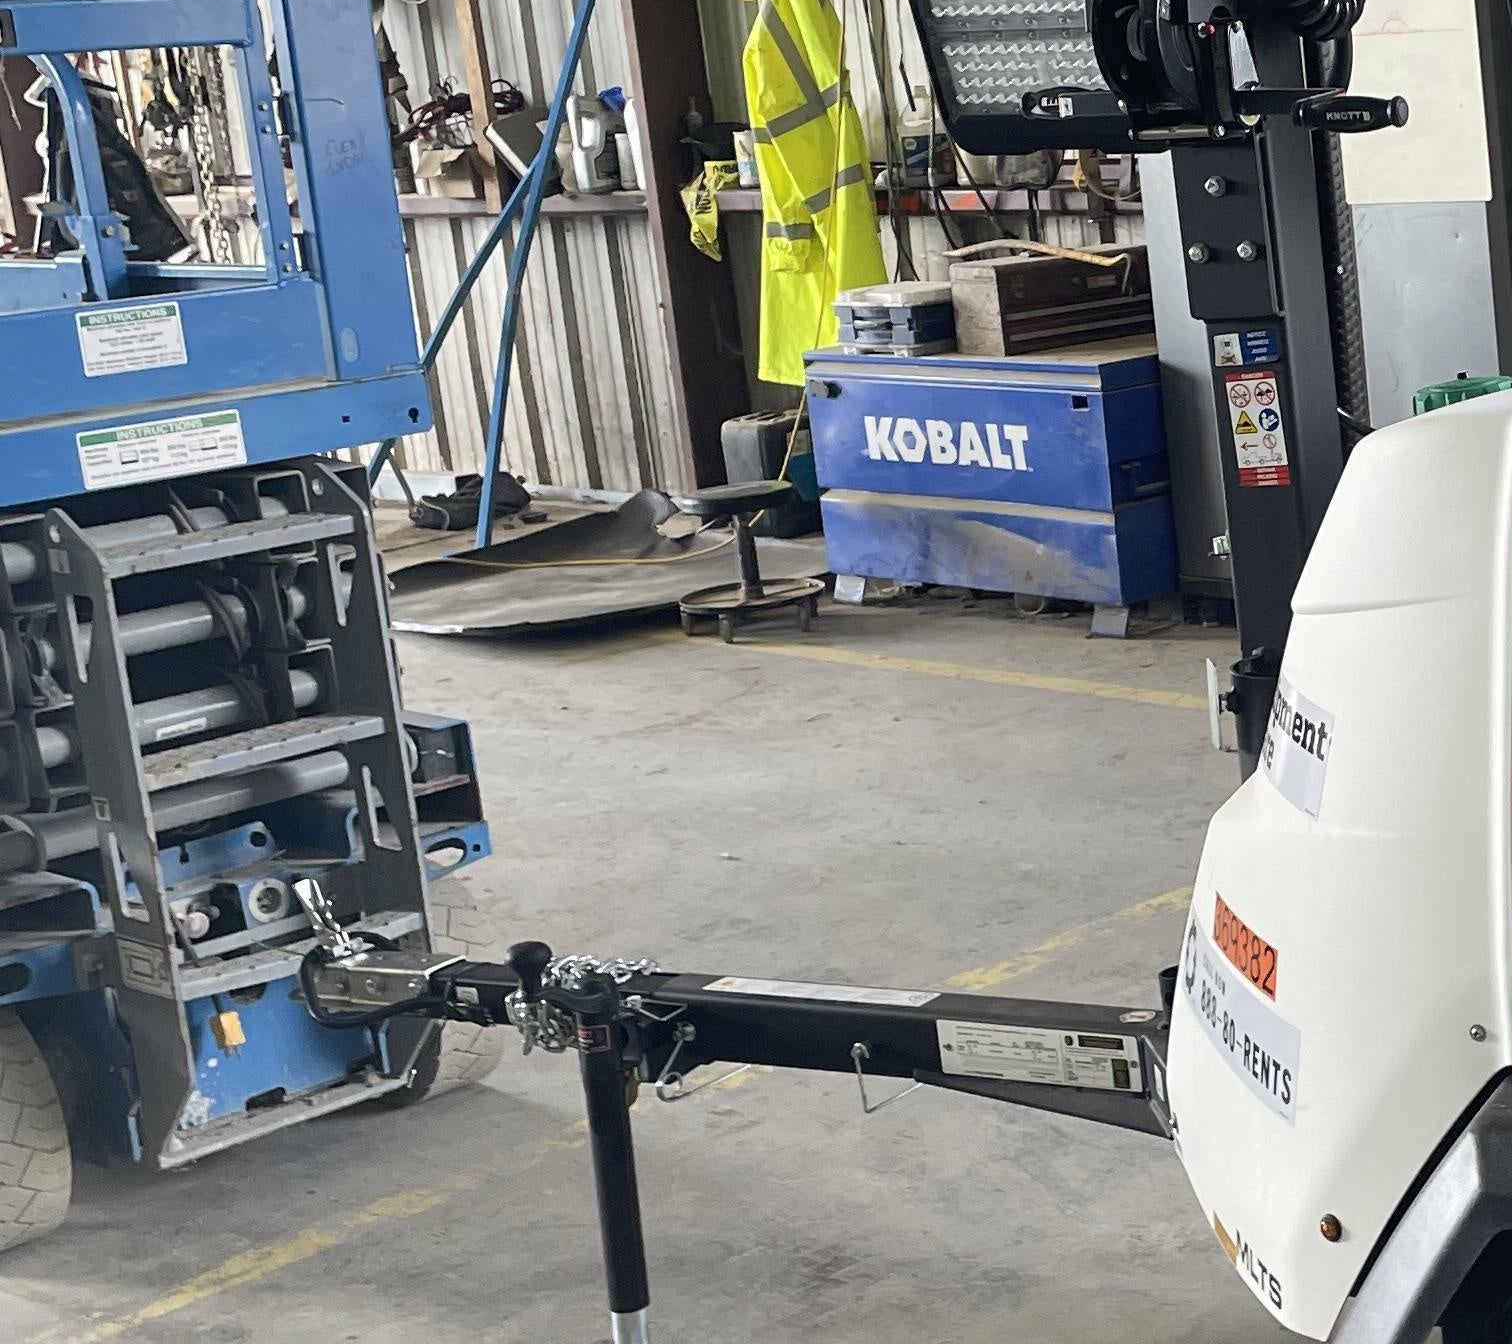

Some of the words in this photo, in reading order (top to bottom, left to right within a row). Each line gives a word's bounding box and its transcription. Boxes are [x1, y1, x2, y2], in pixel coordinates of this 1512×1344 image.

[88, 306, 168, 325] INSTRUCTIONS
[115, 418, 204, 440] INSTRUCTIONS
[863, 414, 1029, 472] KOBALT
[1200, 978, 1293, 1106] 888-80-RENTS
